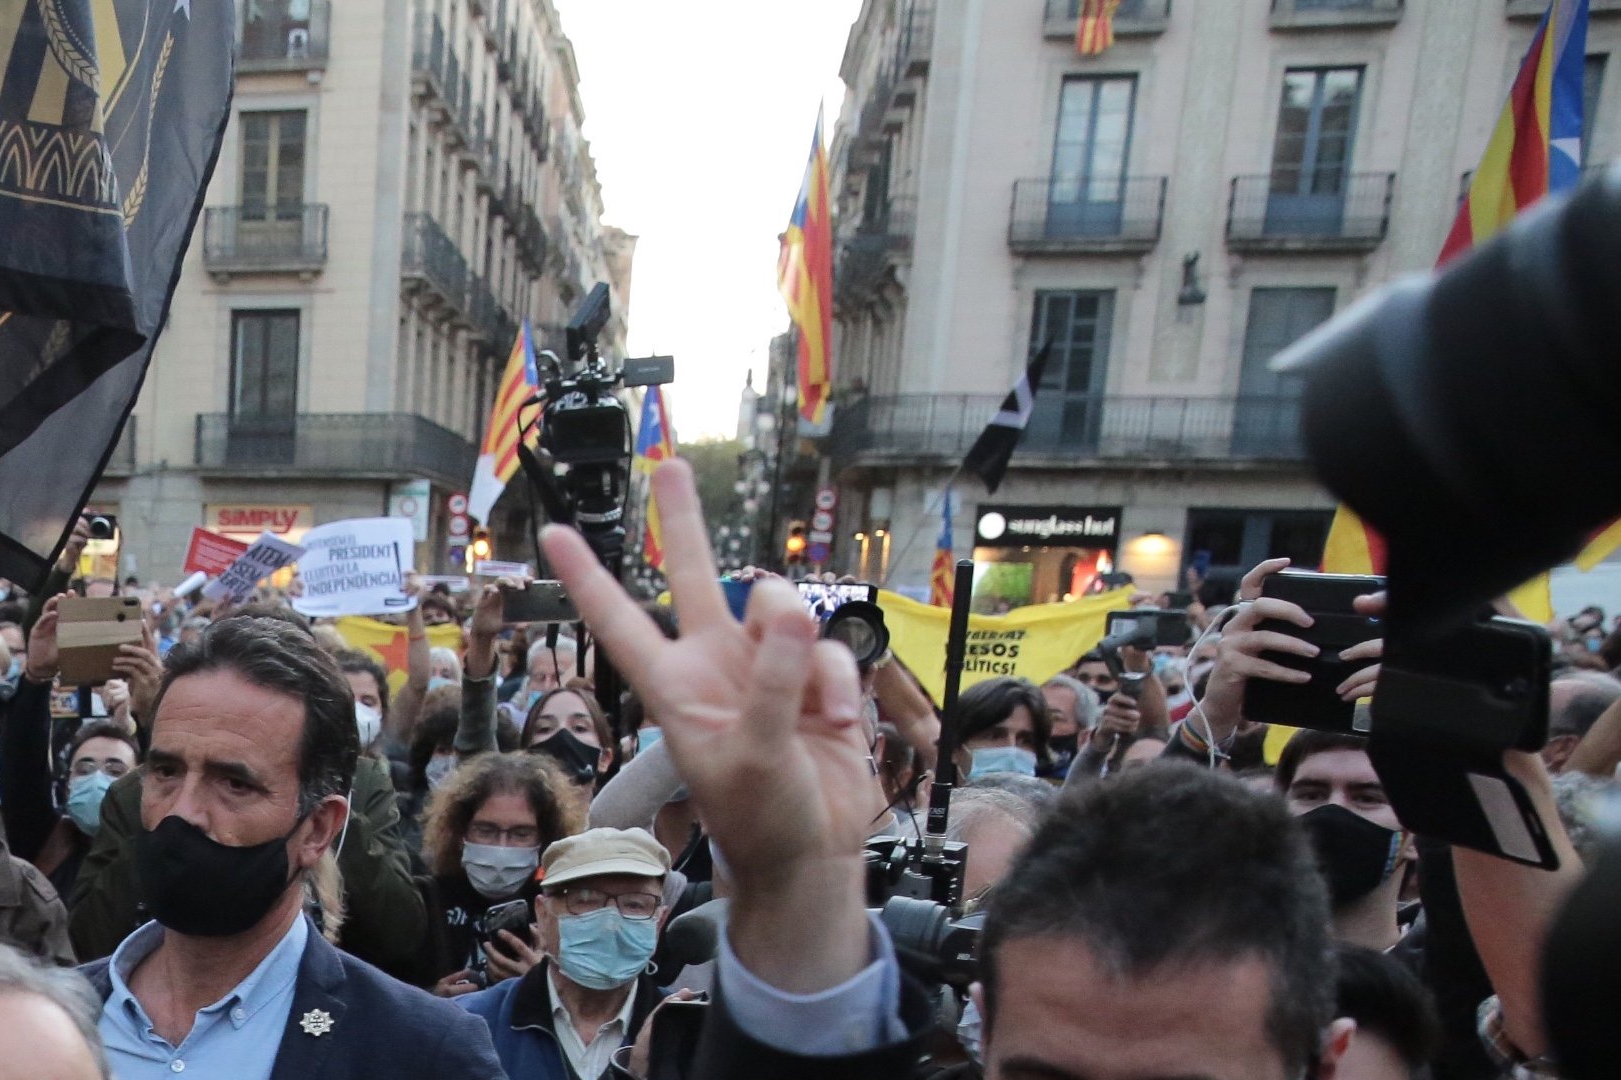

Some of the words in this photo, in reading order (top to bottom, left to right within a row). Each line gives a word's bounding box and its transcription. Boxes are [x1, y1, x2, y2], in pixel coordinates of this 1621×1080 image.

[1007, 514, 1083, 539] sunglass
[328, 544, 391, 561] PRESIDENT
[956, 655, 1016, 676] LÍTICS!
